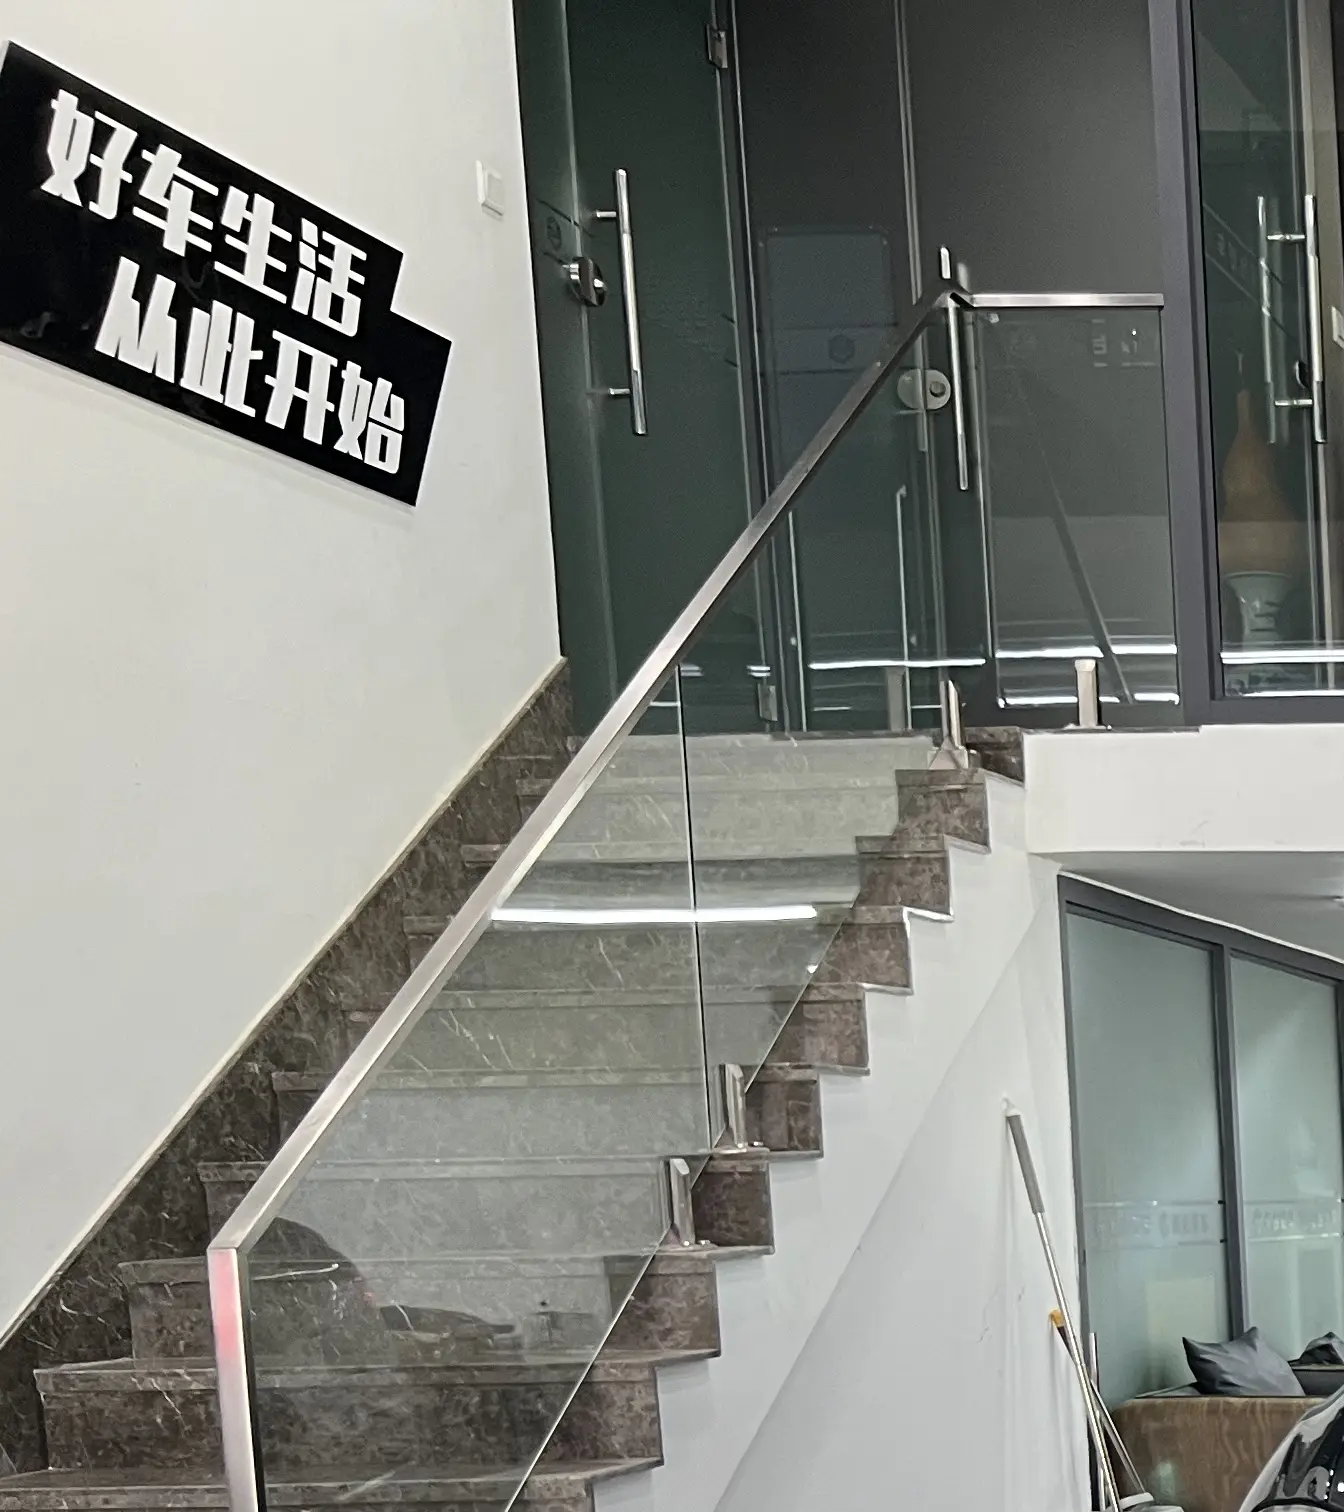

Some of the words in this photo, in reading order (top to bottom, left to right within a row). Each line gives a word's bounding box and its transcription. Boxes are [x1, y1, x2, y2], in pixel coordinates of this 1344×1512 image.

[41, 88, 367, 338] 好车生活
[94, 255, 405, 475] 从此开始
